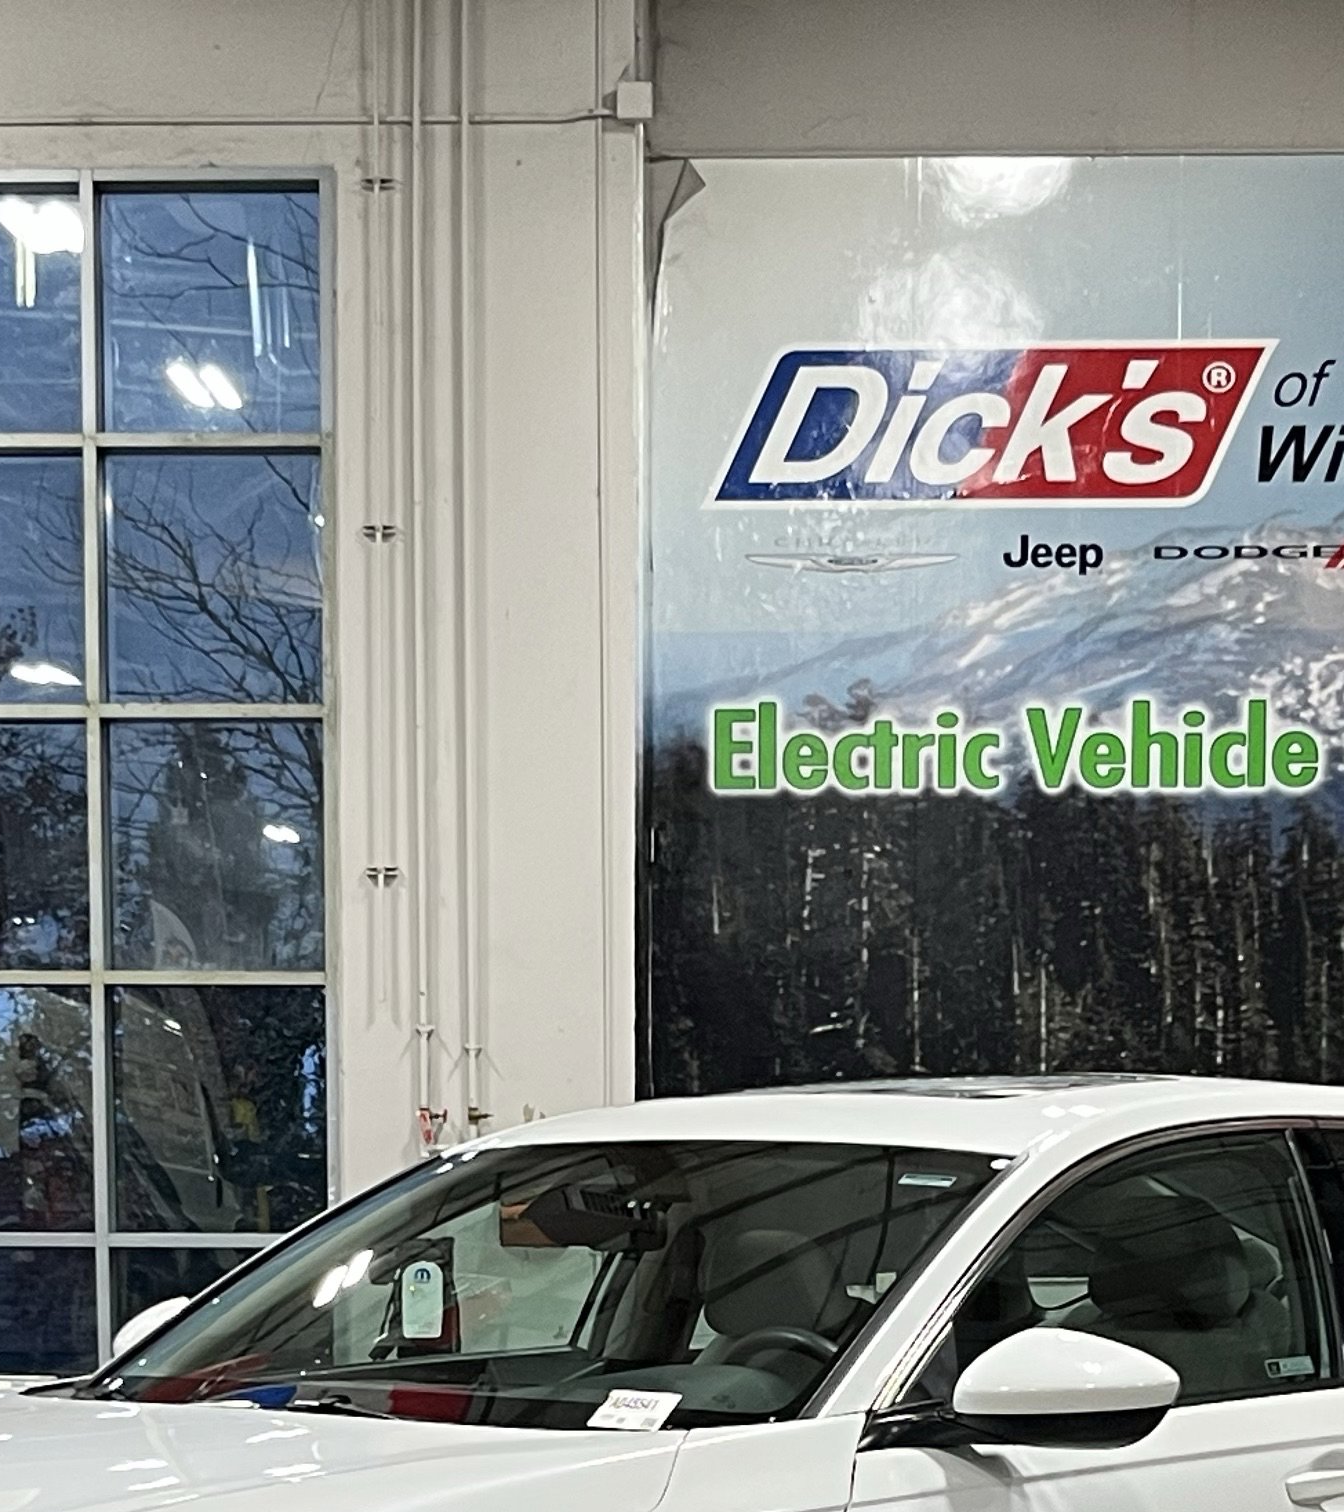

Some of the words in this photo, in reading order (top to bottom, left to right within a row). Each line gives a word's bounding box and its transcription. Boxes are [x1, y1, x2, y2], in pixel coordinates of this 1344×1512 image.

[1273, 359, 1336, 408] of
[749, 359, 1207, 485] Dick's
[1002, 535, 1104, 576] Jeep
[713, 701, 1000, 791] Electric
[1025, 699, 1319, 789] Vehicle
